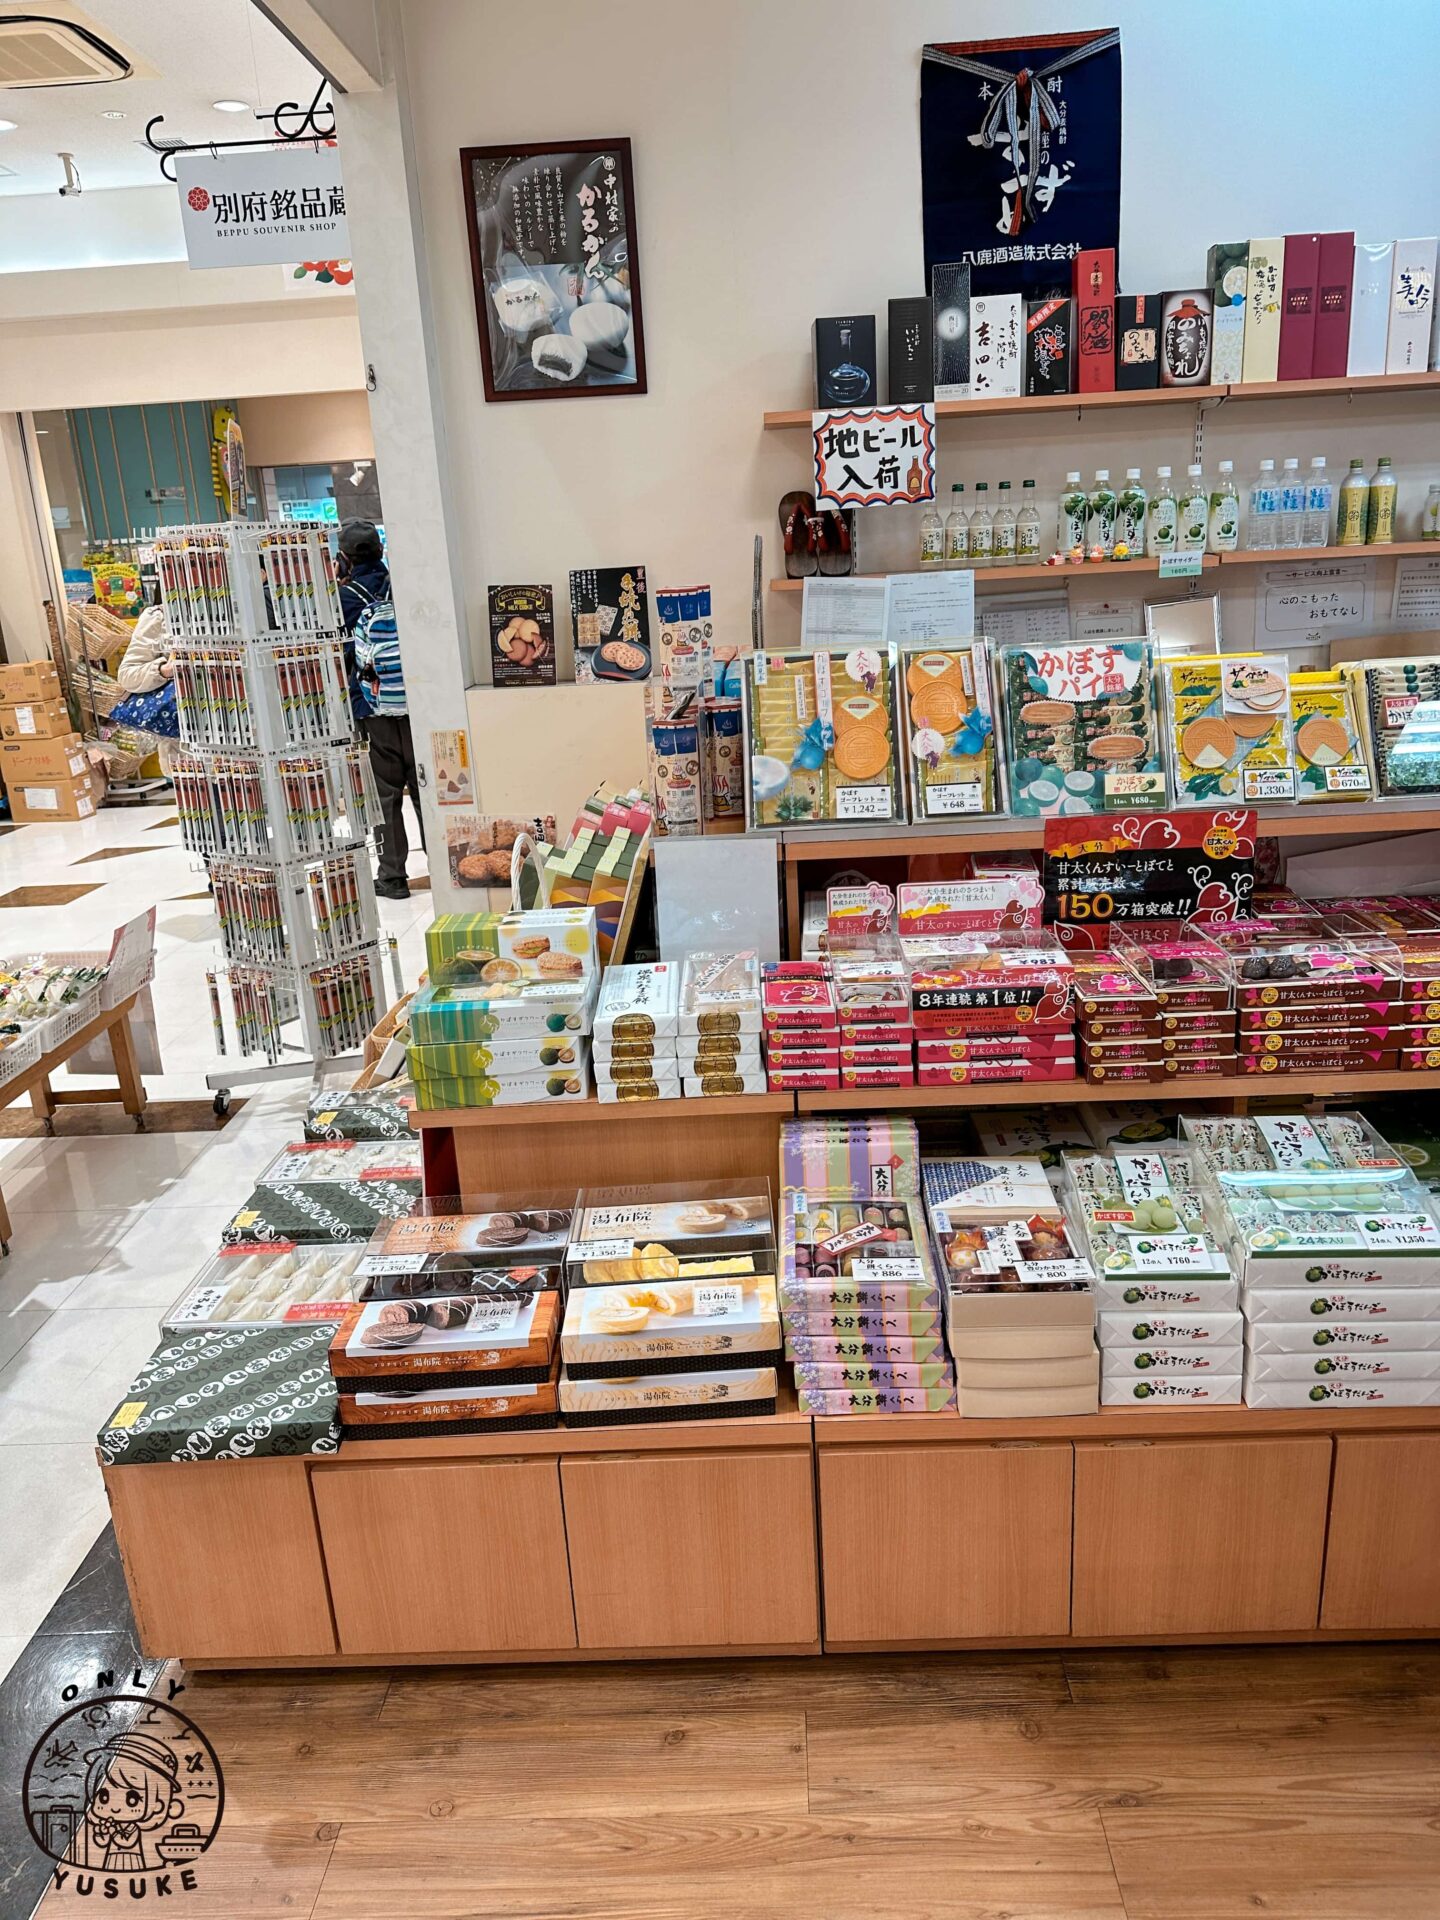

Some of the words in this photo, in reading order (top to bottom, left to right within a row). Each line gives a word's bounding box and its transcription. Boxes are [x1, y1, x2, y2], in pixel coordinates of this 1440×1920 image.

[216, 228, 250, 238] BEPPU
[253, 224, 306, 236] SOUVENIR
[309, 221, 338, 232] SHOP
[576, 183, 605, 279] かるかん
[962, 242, 1083, 266] 八鹿酒造株式会社
[824, 425, 922, 460] 地ビール
[837, 455, 901, 491] 入荷
[1279, 592, 1339, 605] 心のこもった
[1309, 606, 1359, 619] おもてなし
[856, 650, 869, 673] 大分
[1038, 647, 1123, 678] かぼす
[1058, 675, 1104, 698] パイ
[1116, 776, 1145, 785] かぼす
[943, 801, 965, 809] ¥648
[1131, 796, 1149, 804] ¥680
[1078, 842, 1103, 853] 大分
[1057, 877, 1127, 890] 累計販売数
[927, 886, 996, 895] 大分生まれのさつまいも
[1016, 1164, 1030, 1178] 大分
[875, 1167, 889, 1192] 大分
[592, 1211, 652, 1225] 湯布院
[1013, 1223, 1028, 1238] 大分
[1297, 1236, 1344, 1245] 24本入り
[1320, 1270, 1376, 1281] かぼすだんご
[829, 1291, 896, 1304] 大分餅くらべ
[1139, 1291, 1194, 1301] かぼすだんご
[1324, 1301, 1381, 1312] かぼすだんご
[830, 1316, 897, 1329] 大分餅くらべ
[1147, 1326, 1203, 1338] かぼすだんご
[1327, 1332, 1383, 1344] かぼすだんご
[834, 1342, 901, 1355] 大分餅くらべ
[413, 1357, 442, 1367] 湯布院
[1149, 1356, 1204, 1367] かぼすだんご
[1328, 1361, 1384, 1373] かぼすだんご
[841, 1368, 908, 1381] 大分餅くらべ
[1147, 1386, 1203, 1397] かぼすだんご
[1322, 1388, 1378, 1399] かぼすだんご
[848, 1394, 914, 1407] 大分餅くらべ
[422, 1405, 450, 1415] 湯布院
